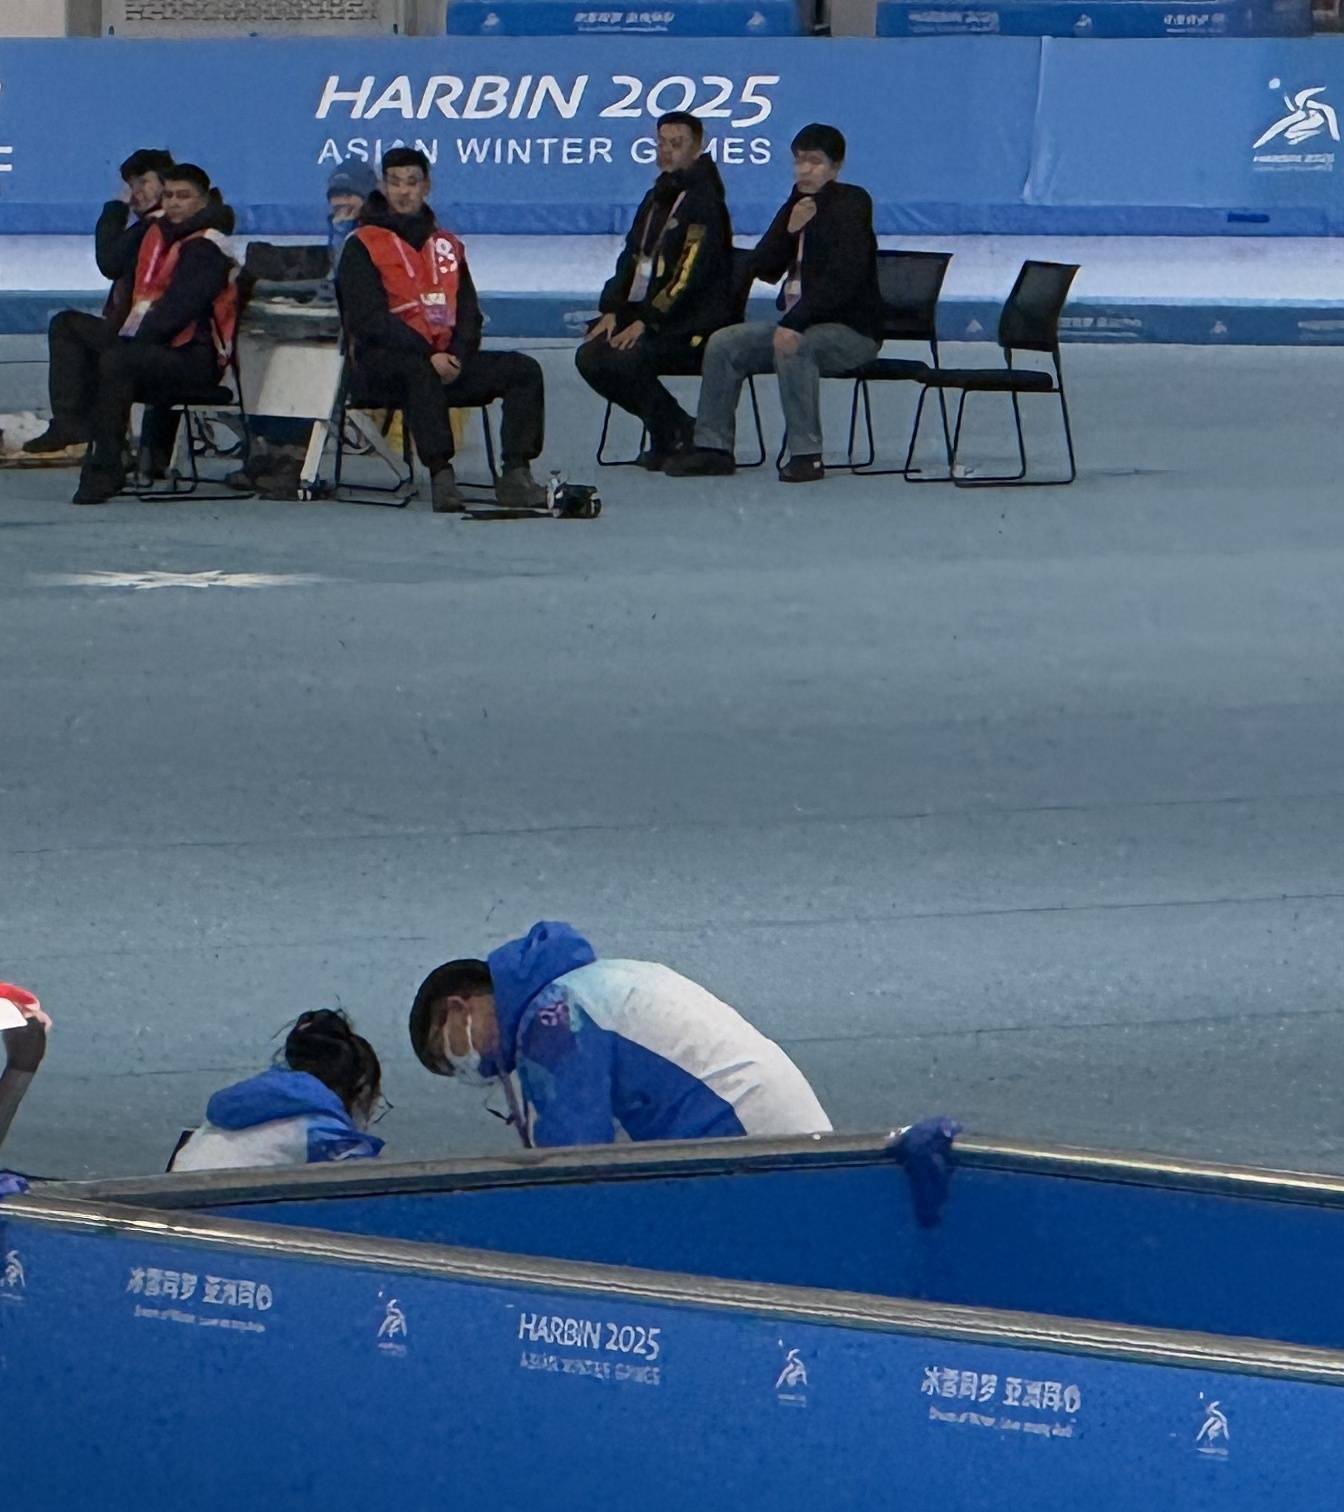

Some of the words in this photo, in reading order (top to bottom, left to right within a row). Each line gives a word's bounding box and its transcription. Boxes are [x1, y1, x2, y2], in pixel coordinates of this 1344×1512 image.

[315, 75, 588, 119] HARBIN
[599, 75, 781, 128] 2025
[457, 138, 613, 165] WINTER
[518, 1312, 601, 1350] HARBIN
[605, 1322, 661, 1361] 2025
